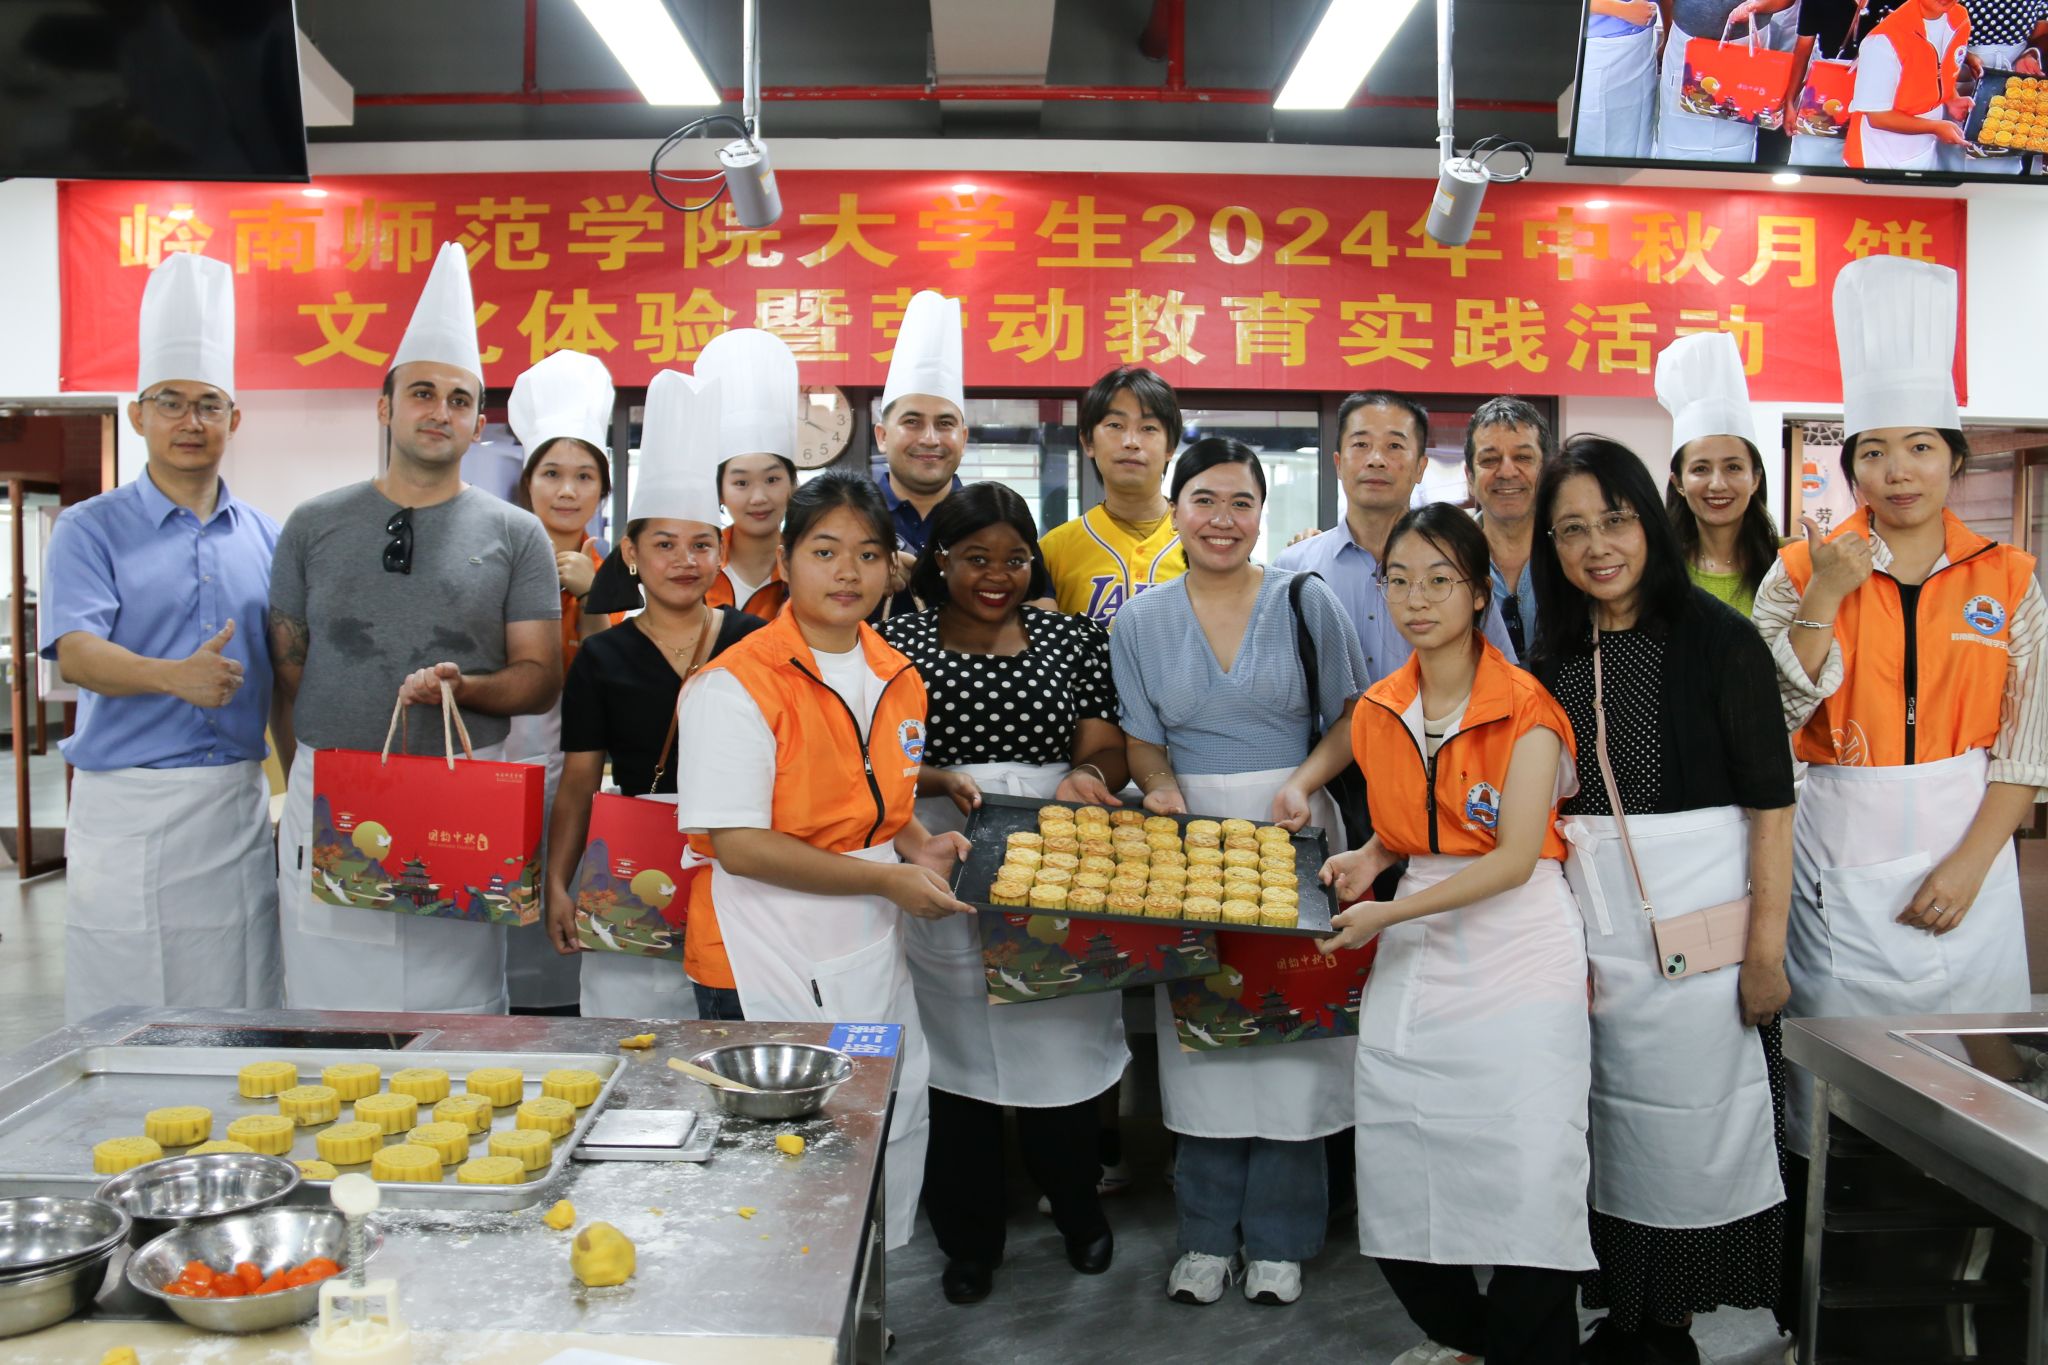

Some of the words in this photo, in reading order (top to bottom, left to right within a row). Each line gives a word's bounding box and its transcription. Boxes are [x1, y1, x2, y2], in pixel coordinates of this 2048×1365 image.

[837, 415, 846, 426] 3
[832, 432, 841, 443] 4
[803, 449, 813, 460] 6
[819, 444, 829, 455] 5
[840, 1025, 889, 1054] 第三组
